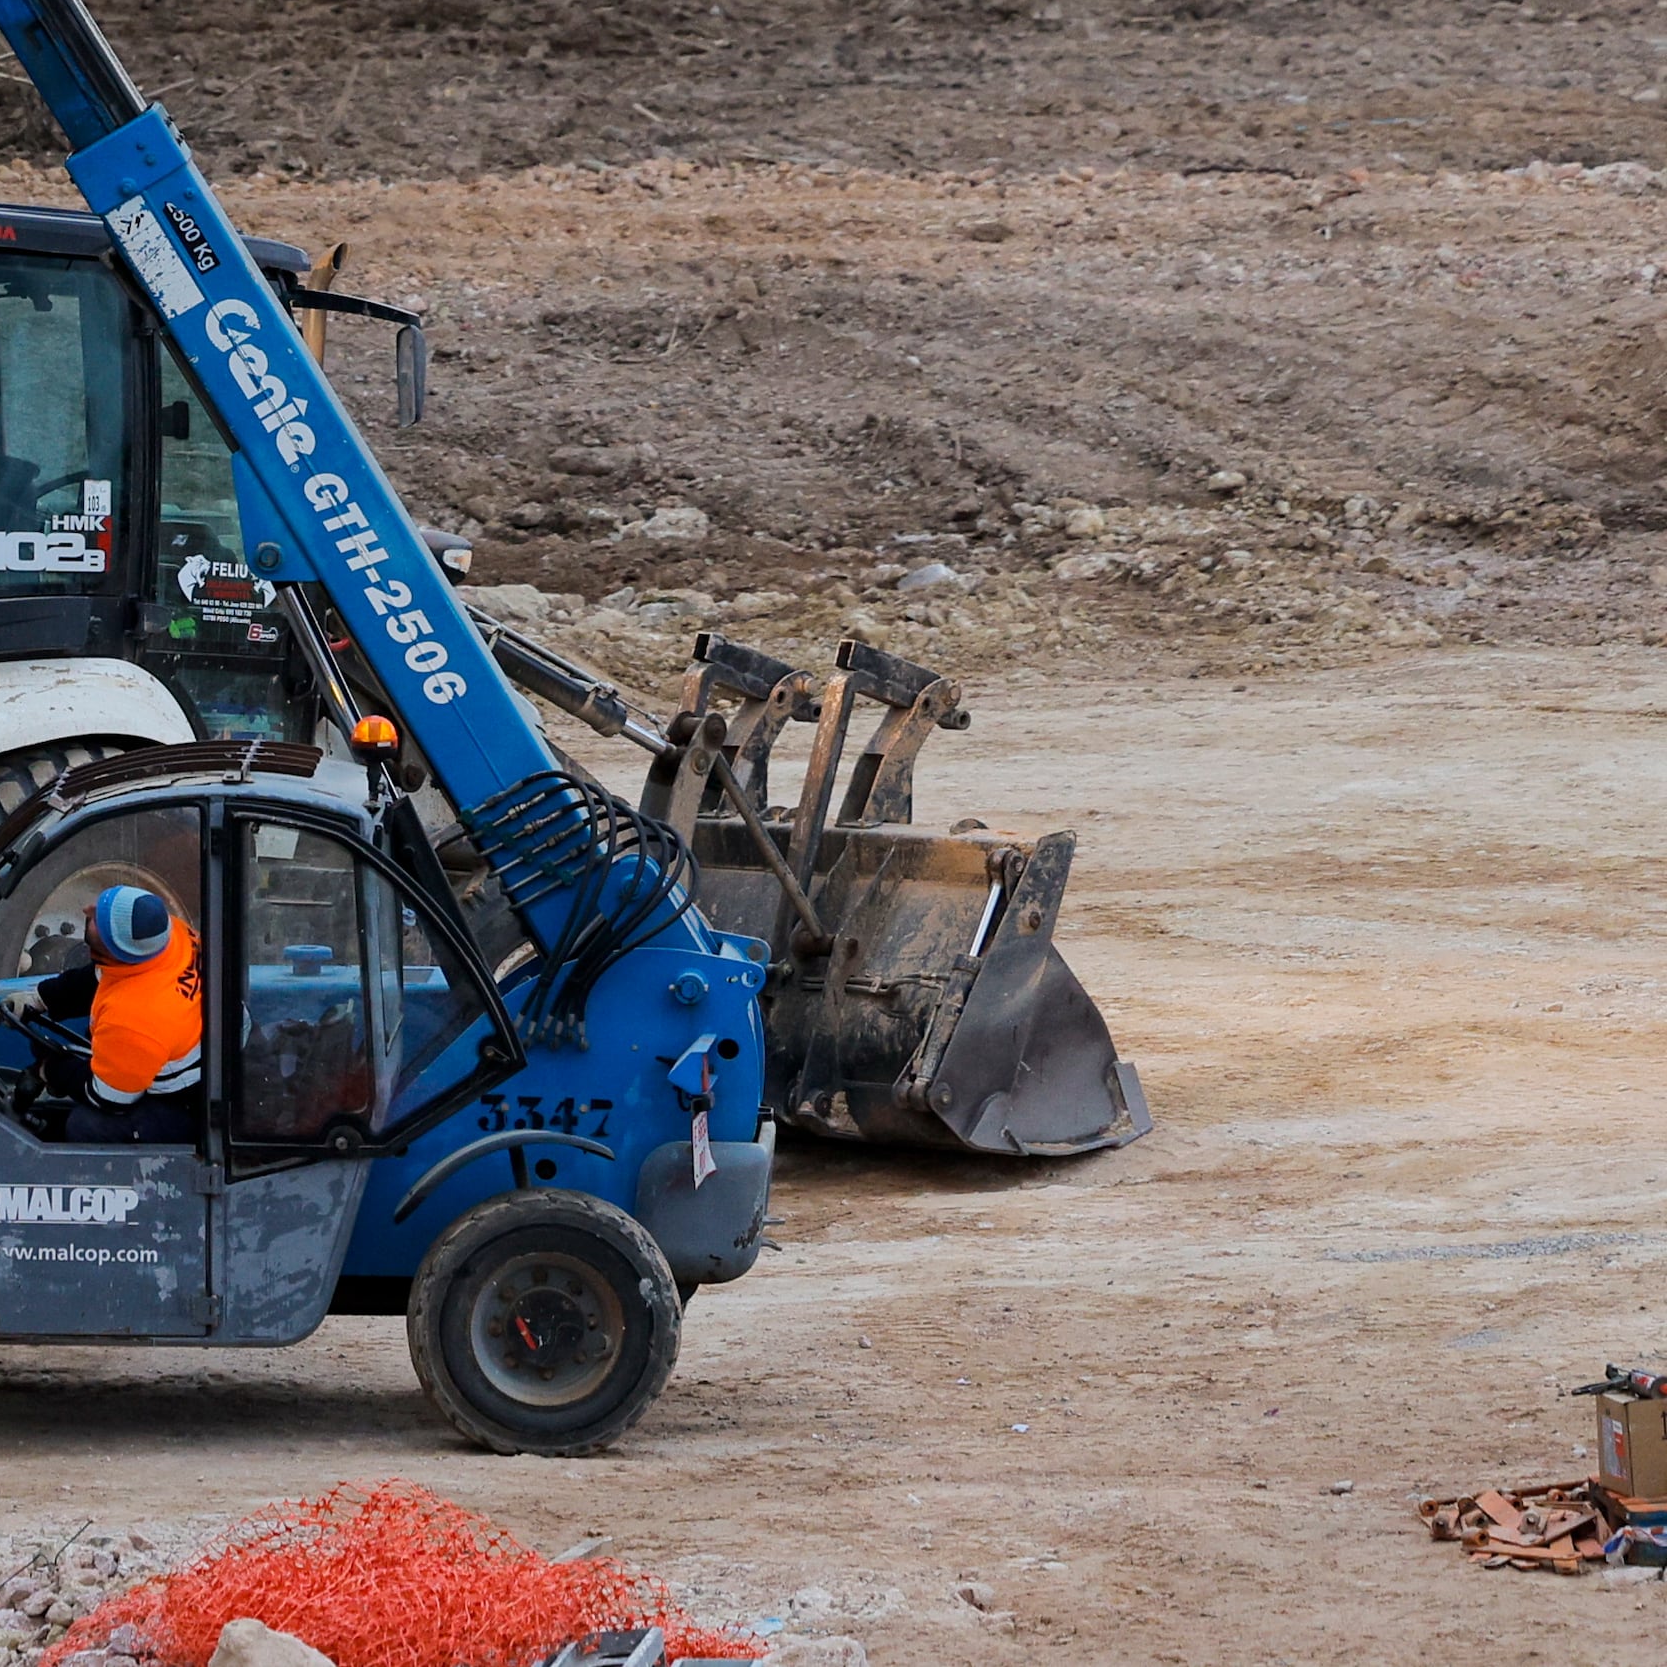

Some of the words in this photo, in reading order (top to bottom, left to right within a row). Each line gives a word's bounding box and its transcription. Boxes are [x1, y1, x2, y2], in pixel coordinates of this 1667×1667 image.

[204, 298, 317, 467] Genie
[303, 472, 467, 706] GTH-2506
[52, 515, 106, 531] HMK
[212, 562, 249, 579] FELIU
[478, 1094, 614, 1137] 3347
